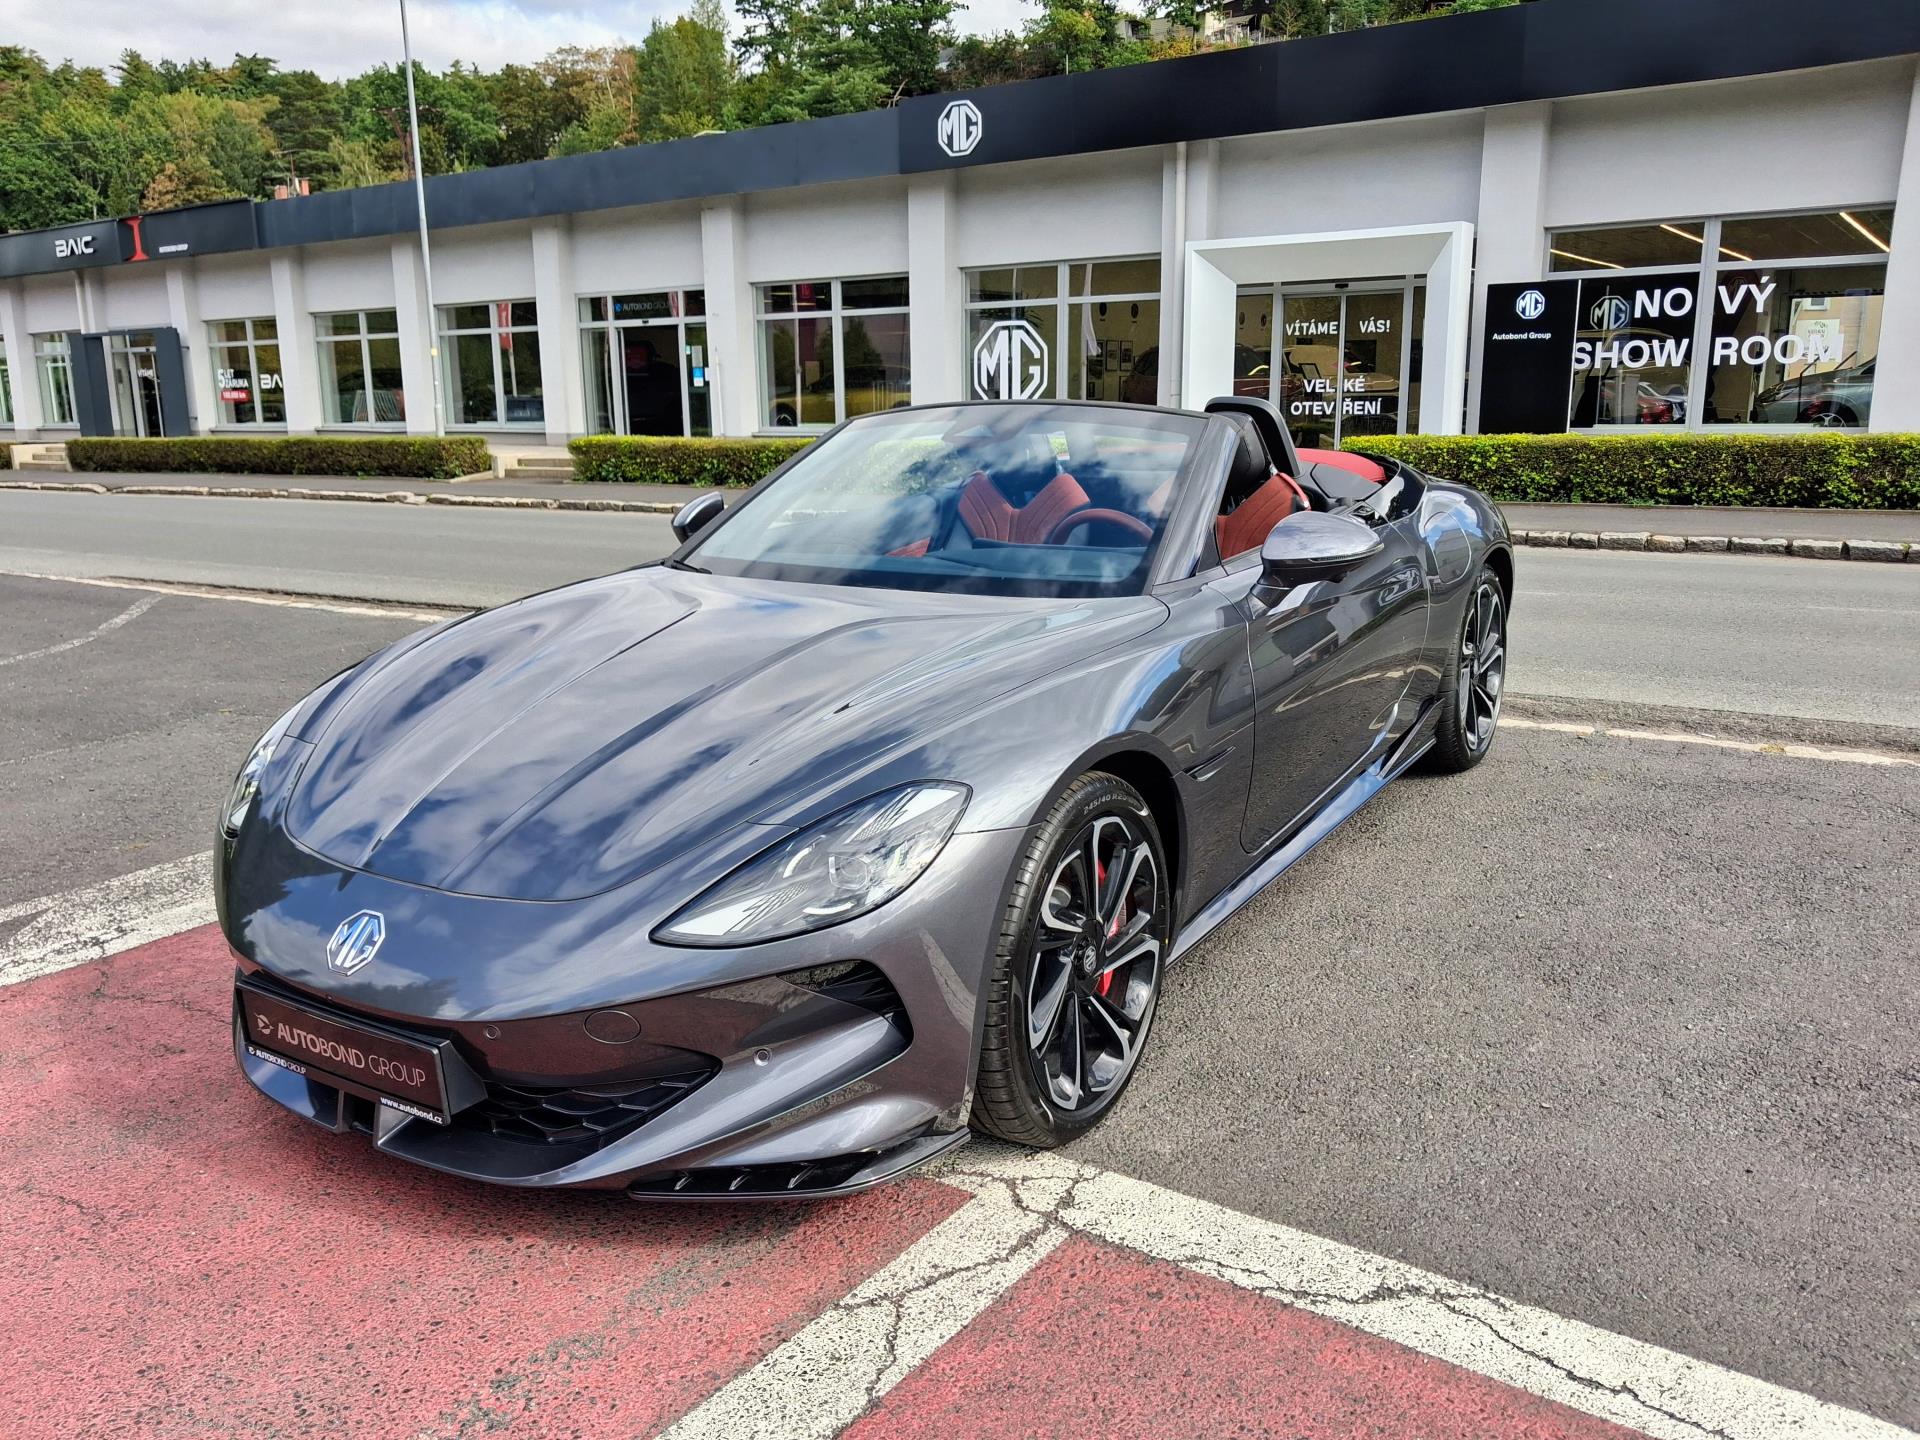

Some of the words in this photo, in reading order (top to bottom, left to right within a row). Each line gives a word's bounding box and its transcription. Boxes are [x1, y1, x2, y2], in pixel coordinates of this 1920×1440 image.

[941, 104, 979, 153] MG
[55, 235, 94, 258] BAIC
[1518, 292, 1543, 318] MG
[1286, 318, 1338, 336] VÍTÁME
[1359, 316, 1391, 333] VÁS!
[1492, 332, 1528, 340] Autobond
[1529, 332, 1552, 340] Group
[979, 327, 1043, 401] MG
[331, 913, 381, 969] MG
[256, 1049, 287, 1068] AUTOBOND
[277, 1022, 365, 1069] AUTOBOND
[368, 1055, 426, 1088] GROUP
[380, 1096, 443, 1125] www.autobond.cz
